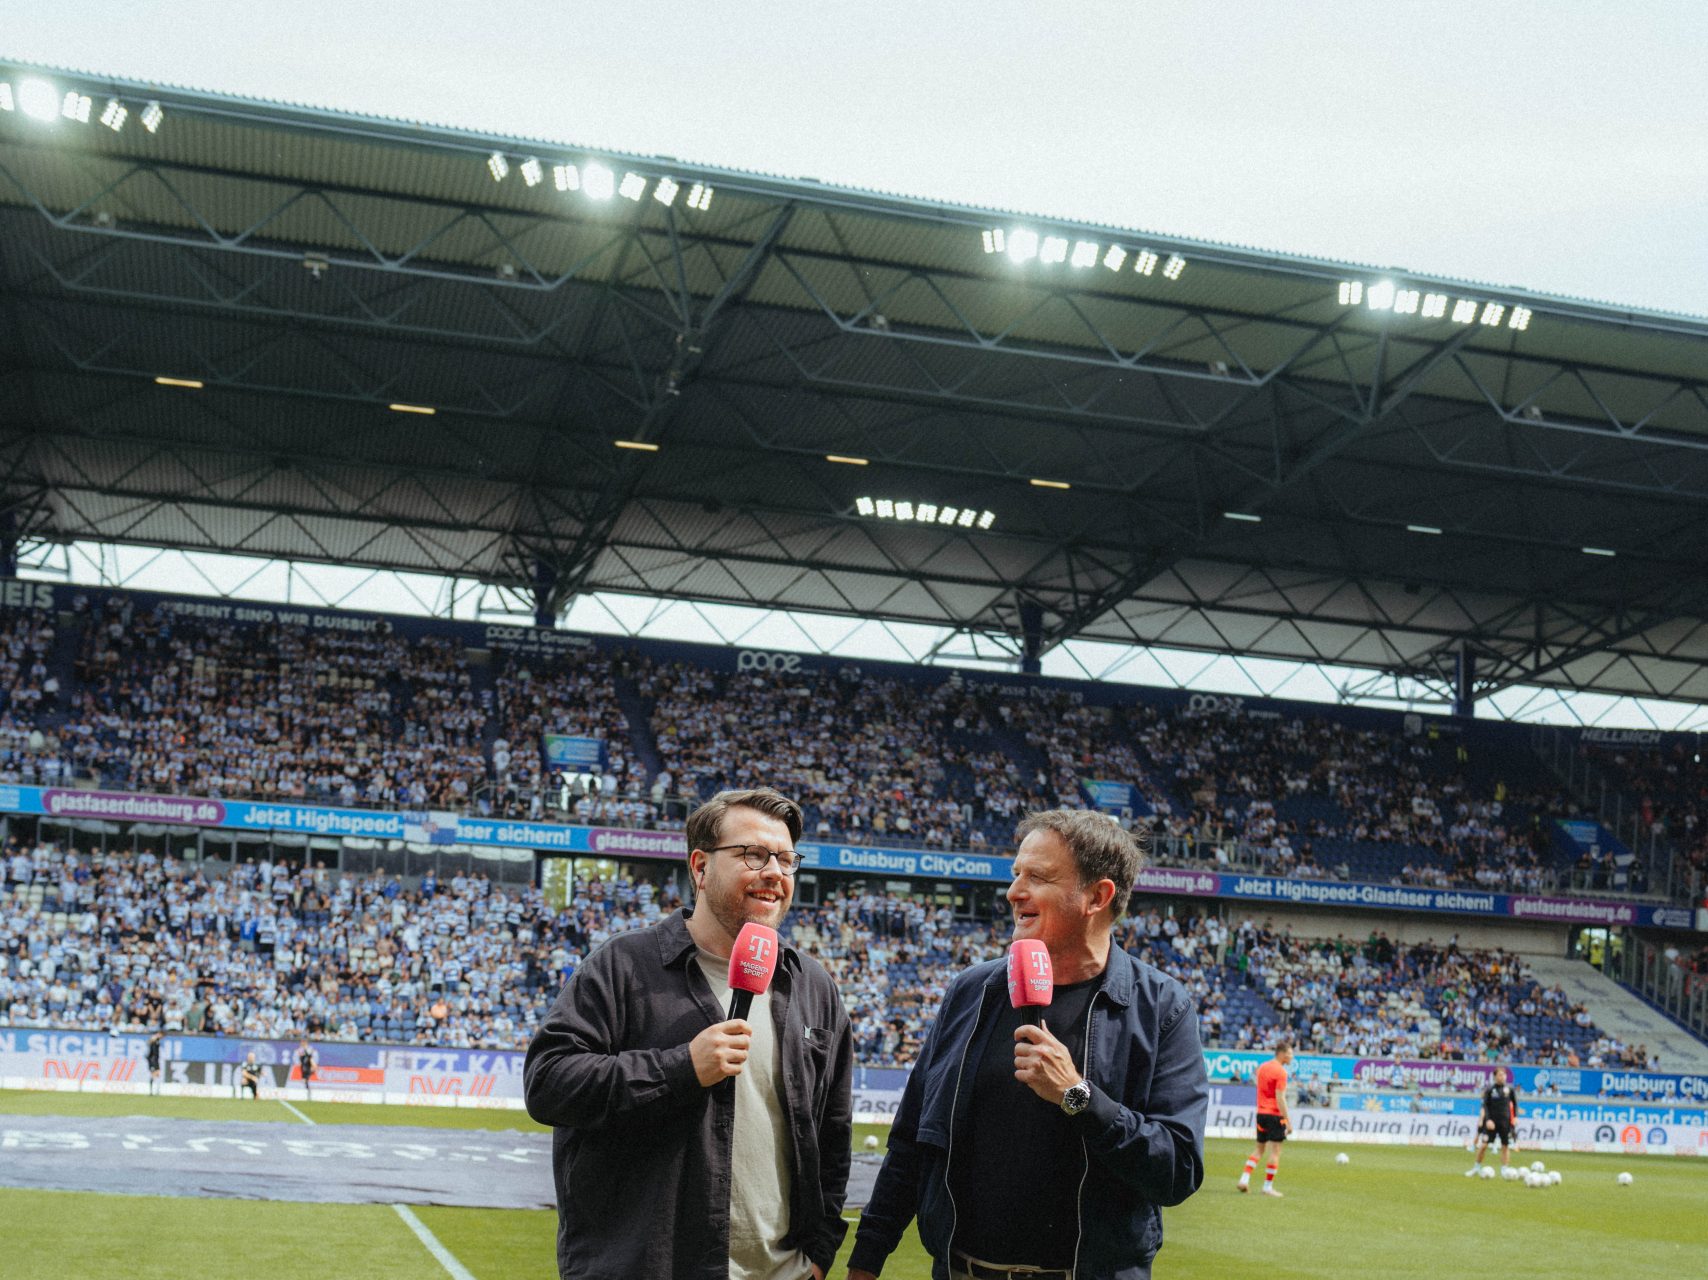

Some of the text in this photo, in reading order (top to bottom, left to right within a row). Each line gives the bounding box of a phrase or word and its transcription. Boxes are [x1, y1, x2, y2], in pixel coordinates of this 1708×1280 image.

[0, 581, 54, 609] EIS
[277, 611, 309, 626] WIR
[1580, 729, 1662, 744] HELLMICH
[51, 793, 218, 822] glasfaserduisburg.de
[244, 806, 292, 826] Jetzt
[497, 825, 571, 846] sichern!
[839, 849, 916, 873] Duisburg
[920, 854, 992, 876] CityCom
[1234, 877, 1495, 911] Jetzt Highspeed-Glasfaser sichern!
[1513, 898, 1633, 923] glasfaserduisburg.de
[739, 960, 769, 975] MAGENTA
[743, 967, 764, 977] SPORT
[27, 1033, 183, 1061] SICHER!
[1602, 1073, 1677, 1093] Duisburg
[1410, 1118, 1430, 1136] in
[1437, 1119, 1471, 1138] die
